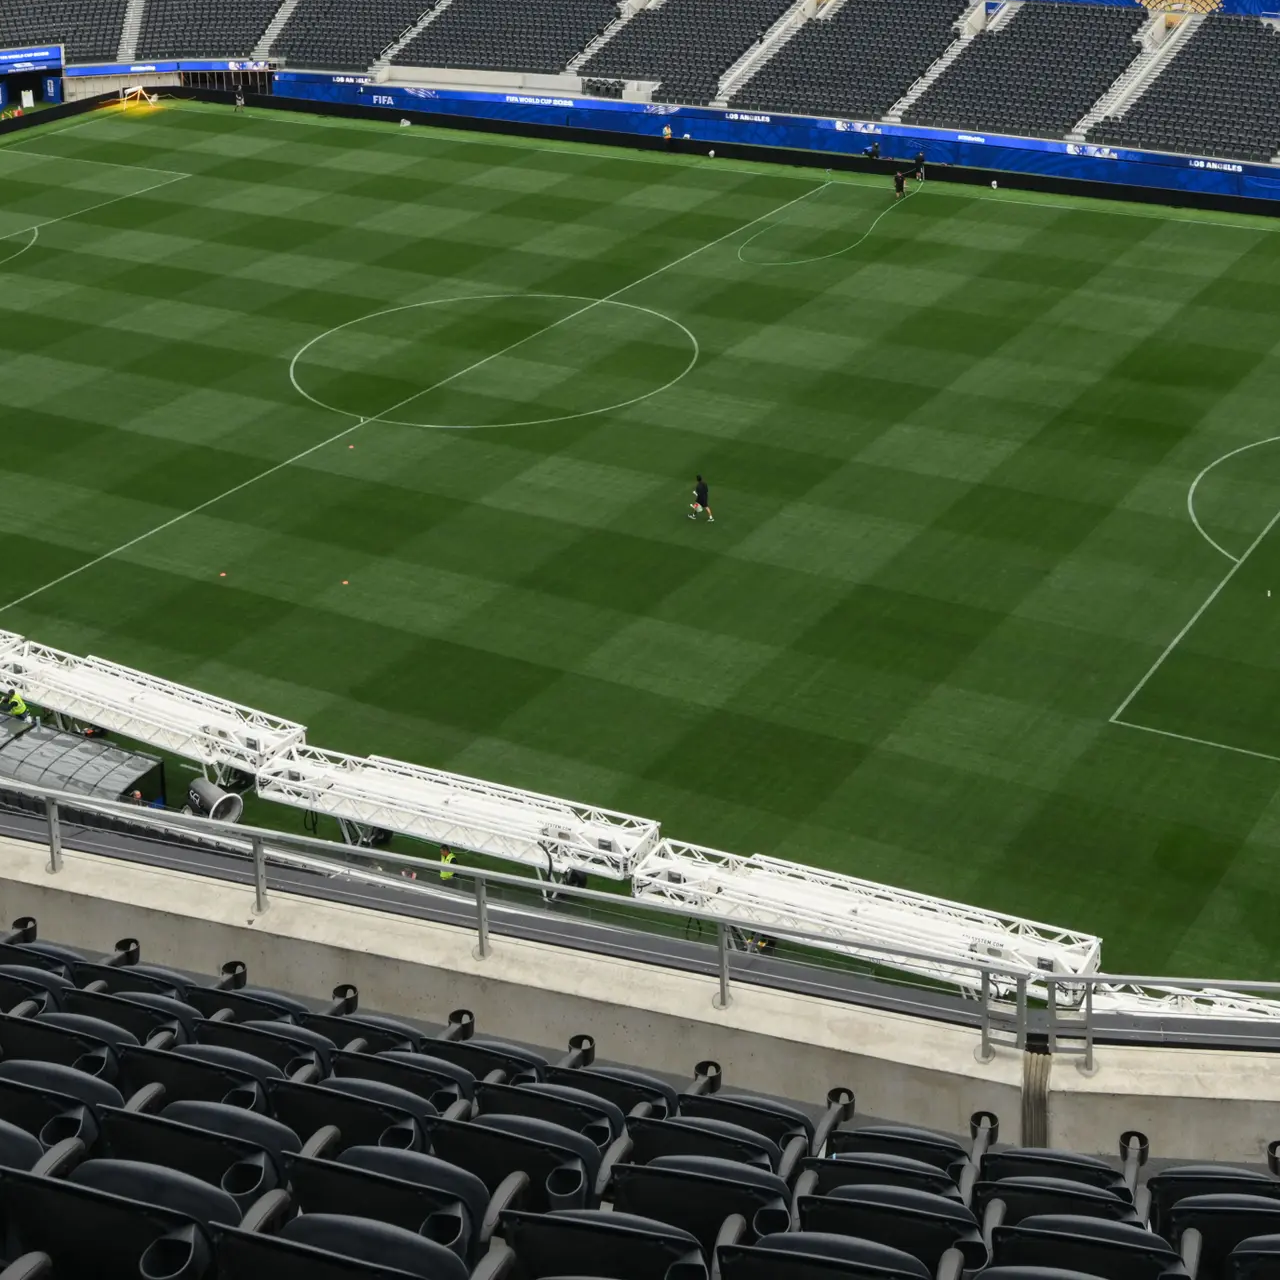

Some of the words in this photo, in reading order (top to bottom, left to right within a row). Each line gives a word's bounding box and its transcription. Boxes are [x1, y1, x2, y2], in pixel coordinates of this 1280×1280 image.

[372, 95, 394, 106] FIFA
[725, 112, 739, 120] LOS
[740, 114, 770, 123] ANGELES
[1189, 159, 1205, 168] LOS
[1206, 161, 1243, 173] ANGELES
